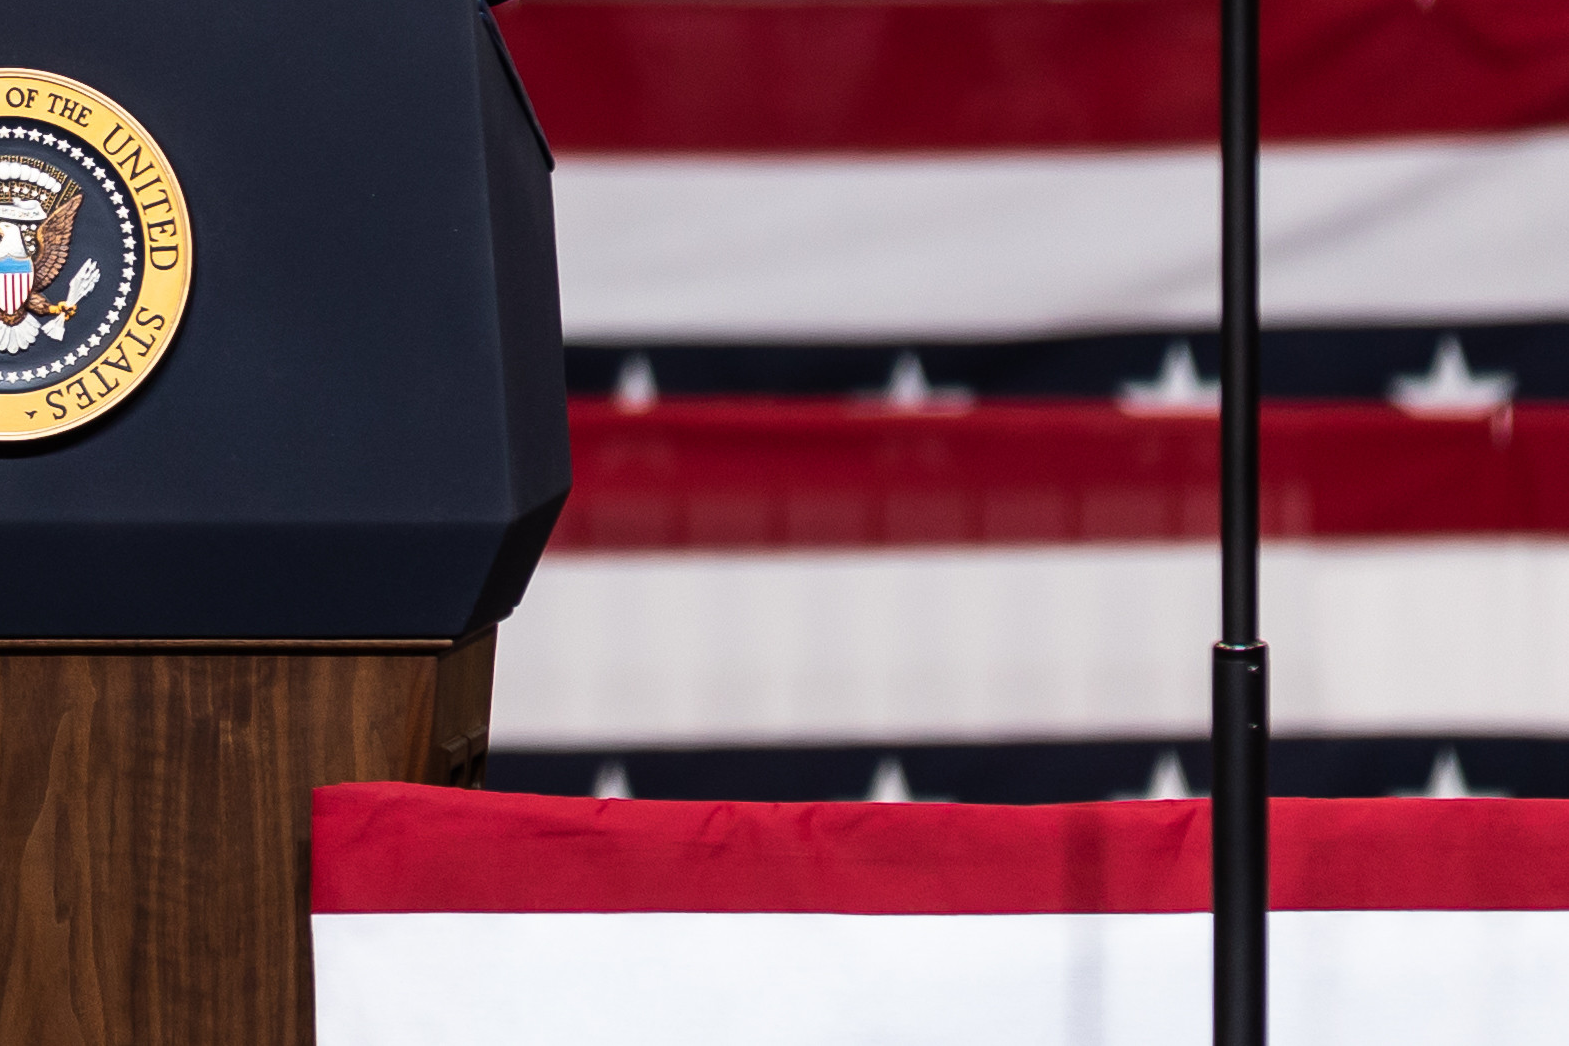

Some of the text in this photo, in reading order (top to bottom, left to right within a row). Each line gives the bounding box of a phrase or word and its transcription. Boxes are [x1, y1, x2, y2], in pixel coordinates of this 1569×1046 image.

[5, 86, 39, 109] OF
[47, 92, 93, 128] THE
[102, 122, 179, 271] UNITED
[45, 306, 166, 421] STATES
